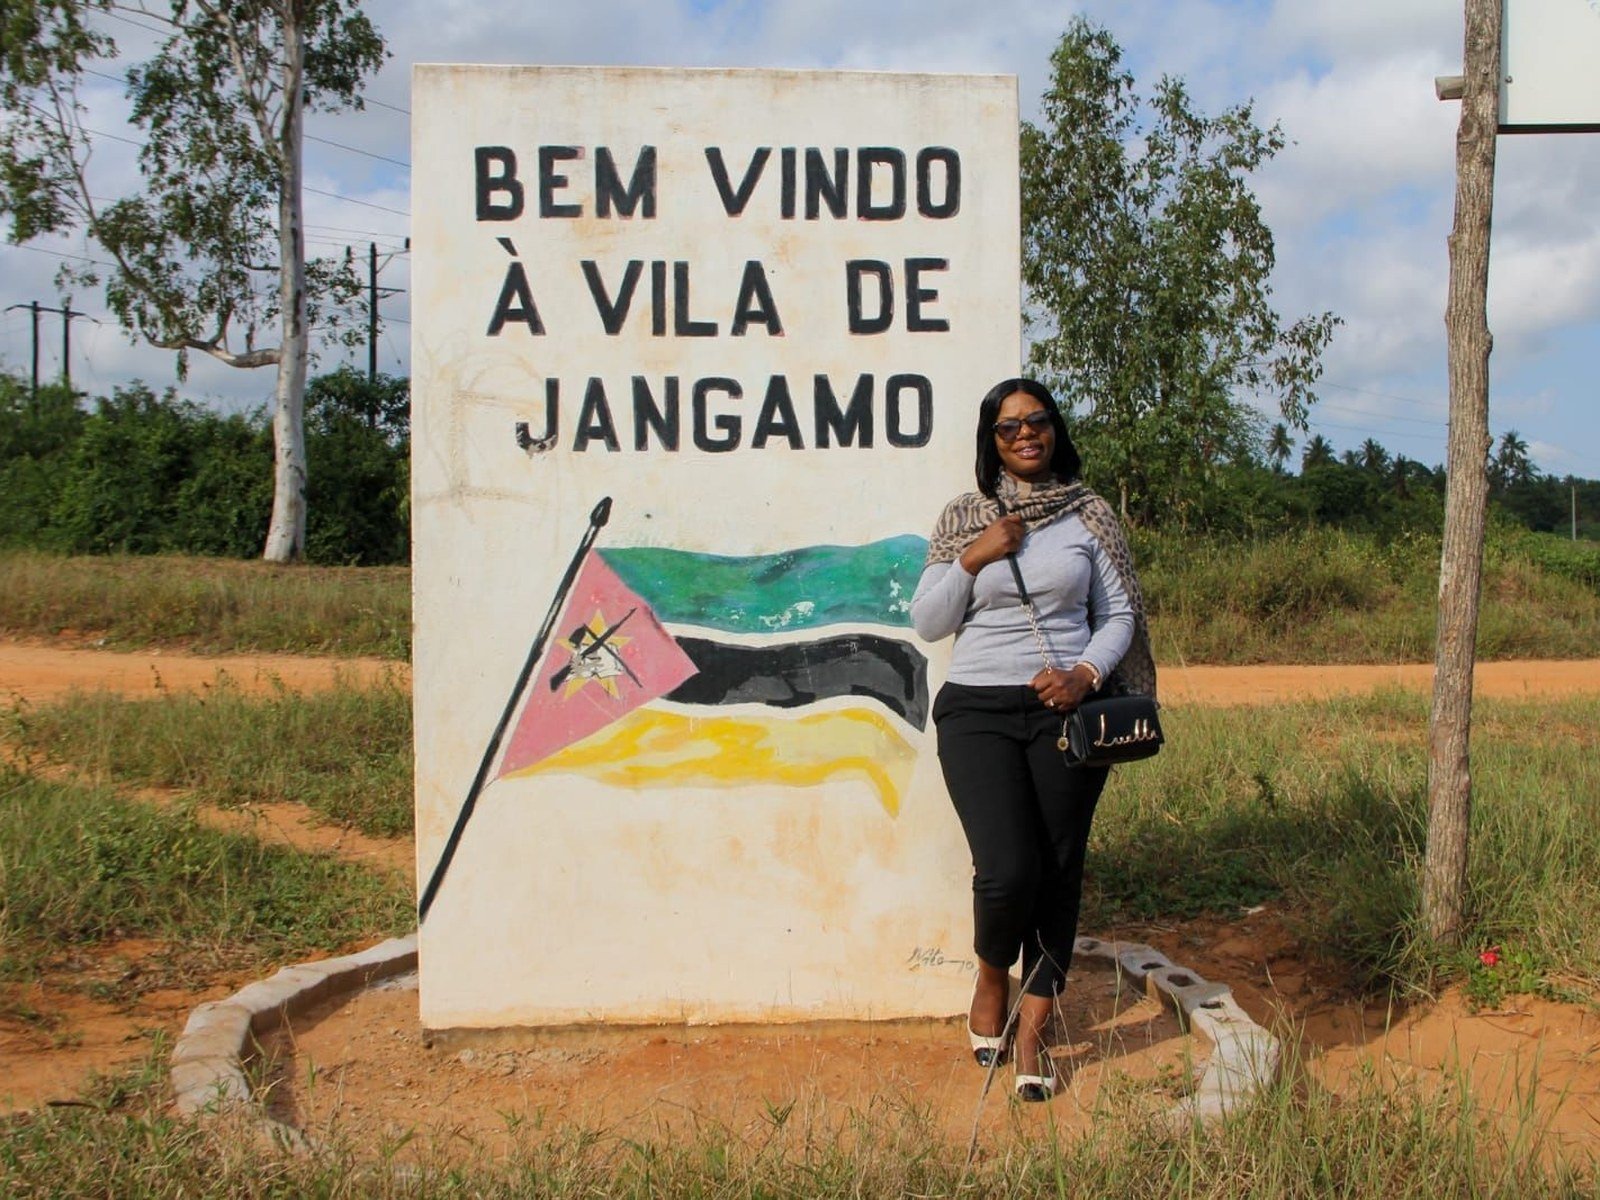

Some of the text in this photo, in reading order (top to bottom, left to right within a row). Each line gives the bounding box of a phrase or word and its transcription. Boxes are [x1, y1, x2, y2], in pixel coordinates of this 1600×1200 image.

[474, 145, 961, 221] BEM VINDO
[487, 237, 950, 336] À VILA DE
[515, 373, 933, 453] JANGAMO
